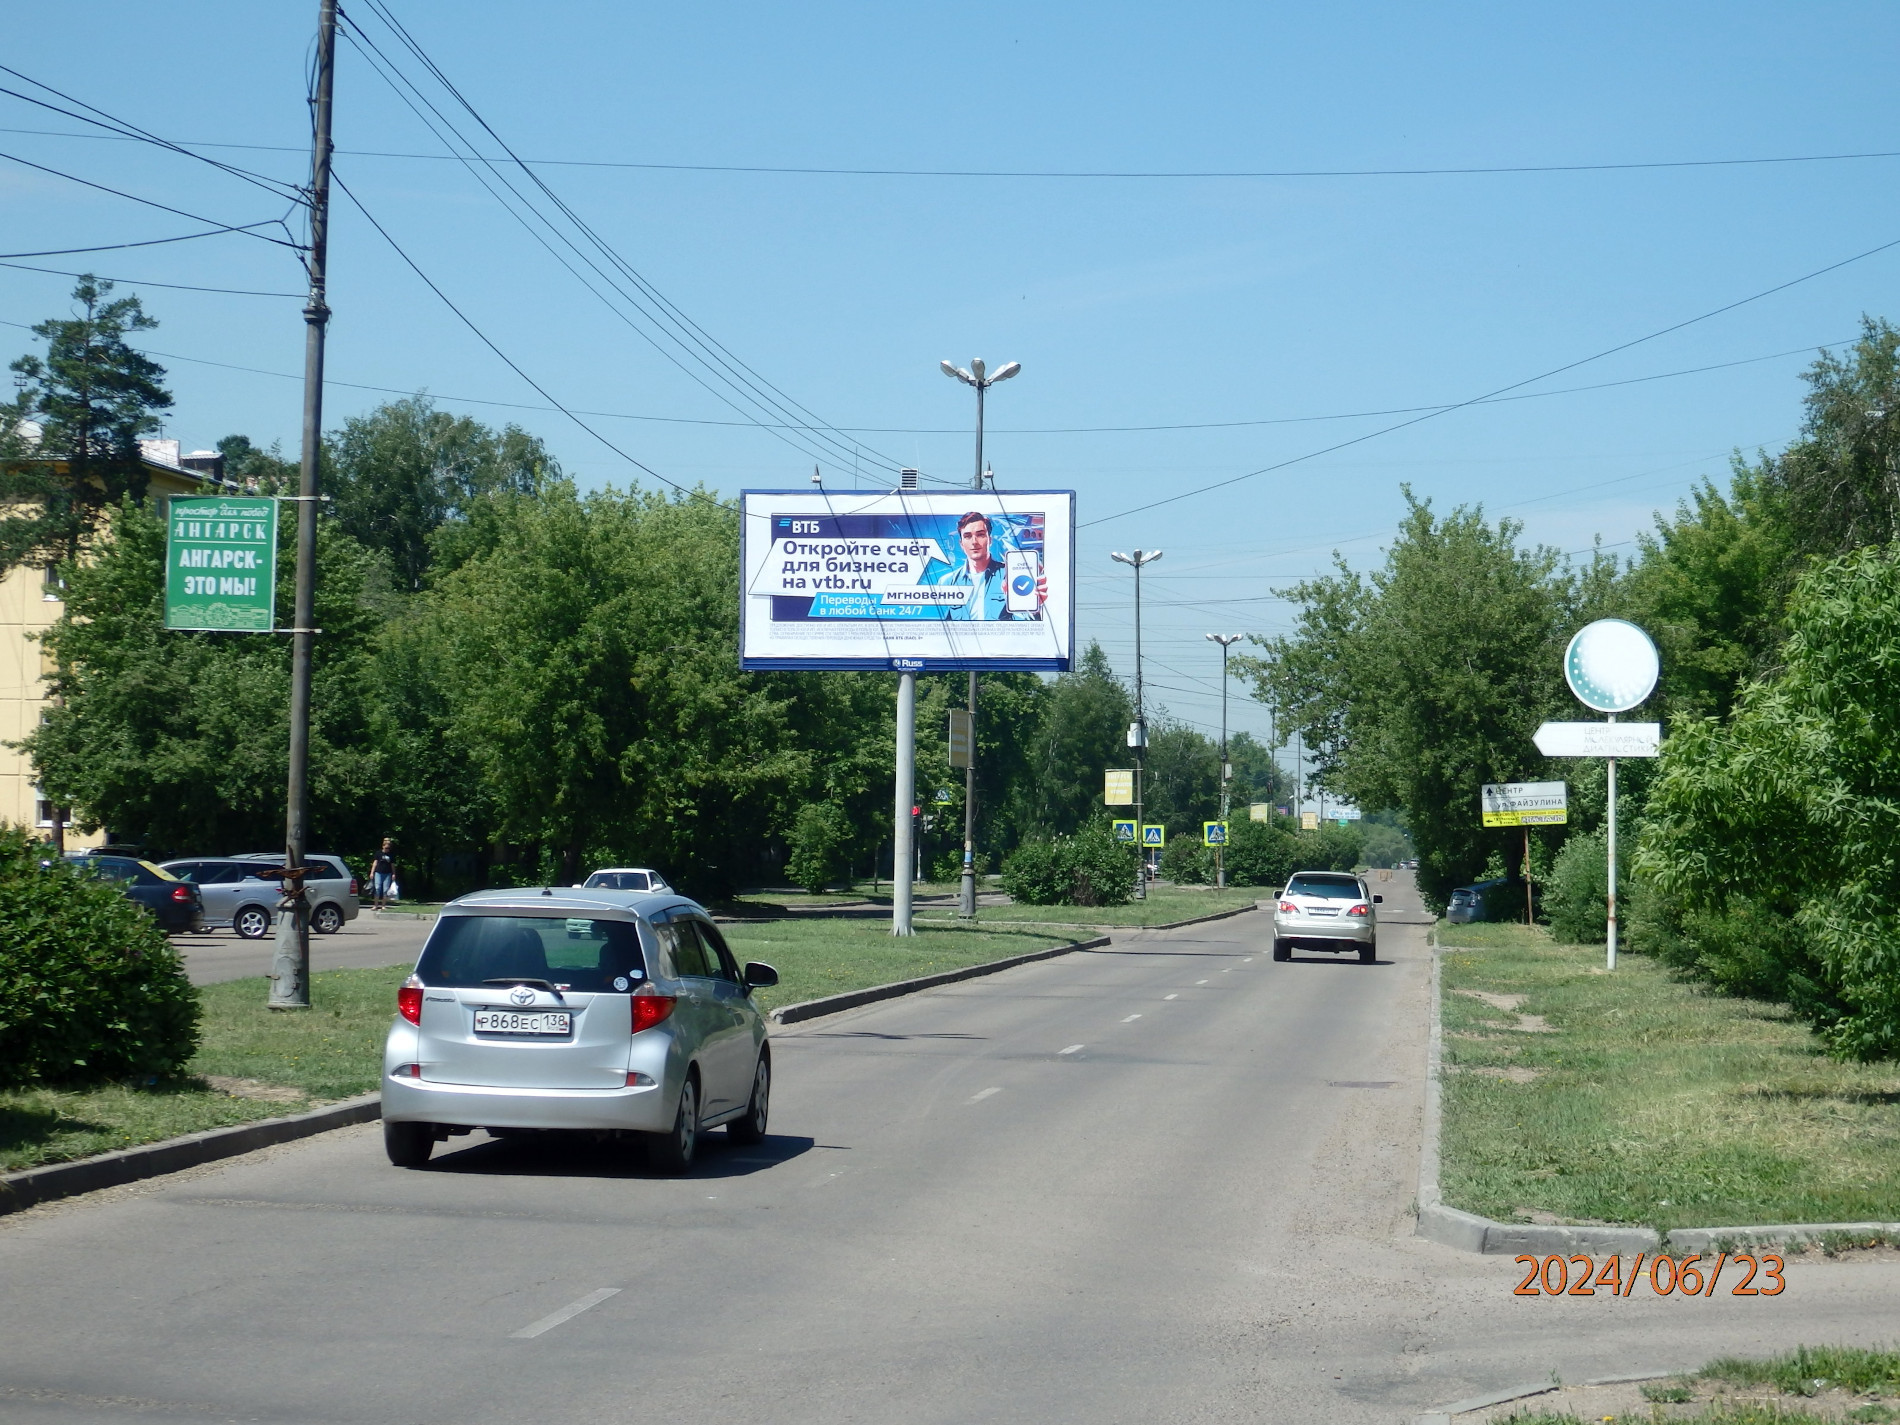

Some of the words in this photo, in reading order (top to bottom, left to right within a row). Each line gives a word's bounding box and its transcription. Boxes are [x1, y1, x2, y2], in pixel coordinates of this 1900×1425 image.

[174, 521, 267, 539] АНГАРСК
[792, 520, 820, 534] ВТБ
[783, 540, 881, 559] Откройте
[887, 541, 930, 557] счёт
[179, 548, 263, 569] АНГАРСК-
[782, 560, 820, 574] для
[826, 557, 909, 573] бизнеса
[184, 576, 216, 595] ЭТО
[220, 577, 257, 596] МЫ!
[782, 577, 806, 589] на
[812, 574, 872, 590] vtb.ru
[820, 594, 877, 606] Переводы
[887, 591, 965, 600] мгновенно
[820, 607, 826, 615] в
[829, 605, 867, 615] любой
[869, 605, 896, 616] банк
[899, 605, 923, 616] 24/7
[902, 659, 924, 667] Russ
[1584, 726, 1611, 736] ЦЕНТР
[1495, 787, 1524, 795] ЦЕНТР
